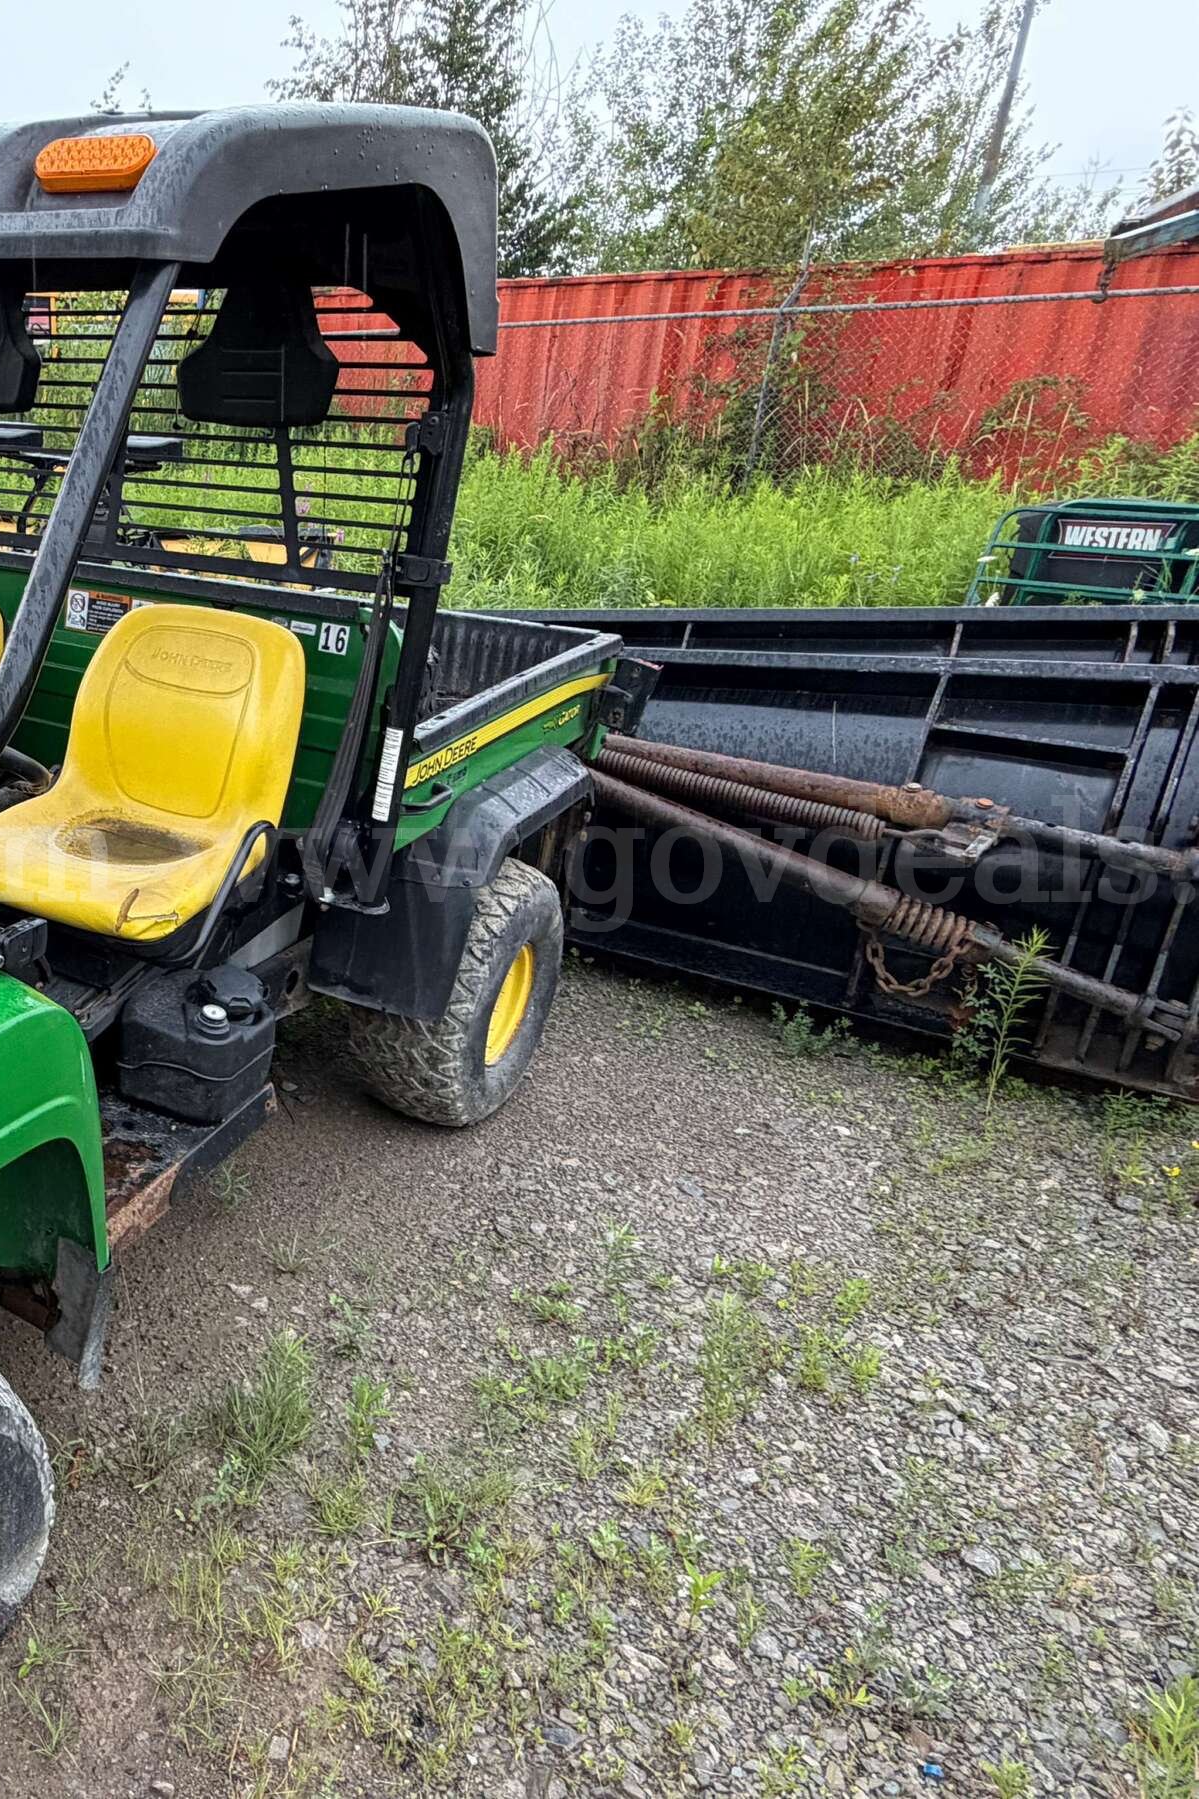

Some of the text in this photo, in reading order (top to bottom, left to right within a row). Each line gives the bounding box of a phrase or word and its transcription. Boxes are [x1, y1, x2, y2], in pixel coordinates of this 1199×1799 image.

[1064, 525, 1162, 551] WESTERN
[321, 625, 347, 653] 16
[151, 646, 189, 667] JOHN
[412, 754, 443, 784] JOHN
[443, 736, 478, 766] DEERE
